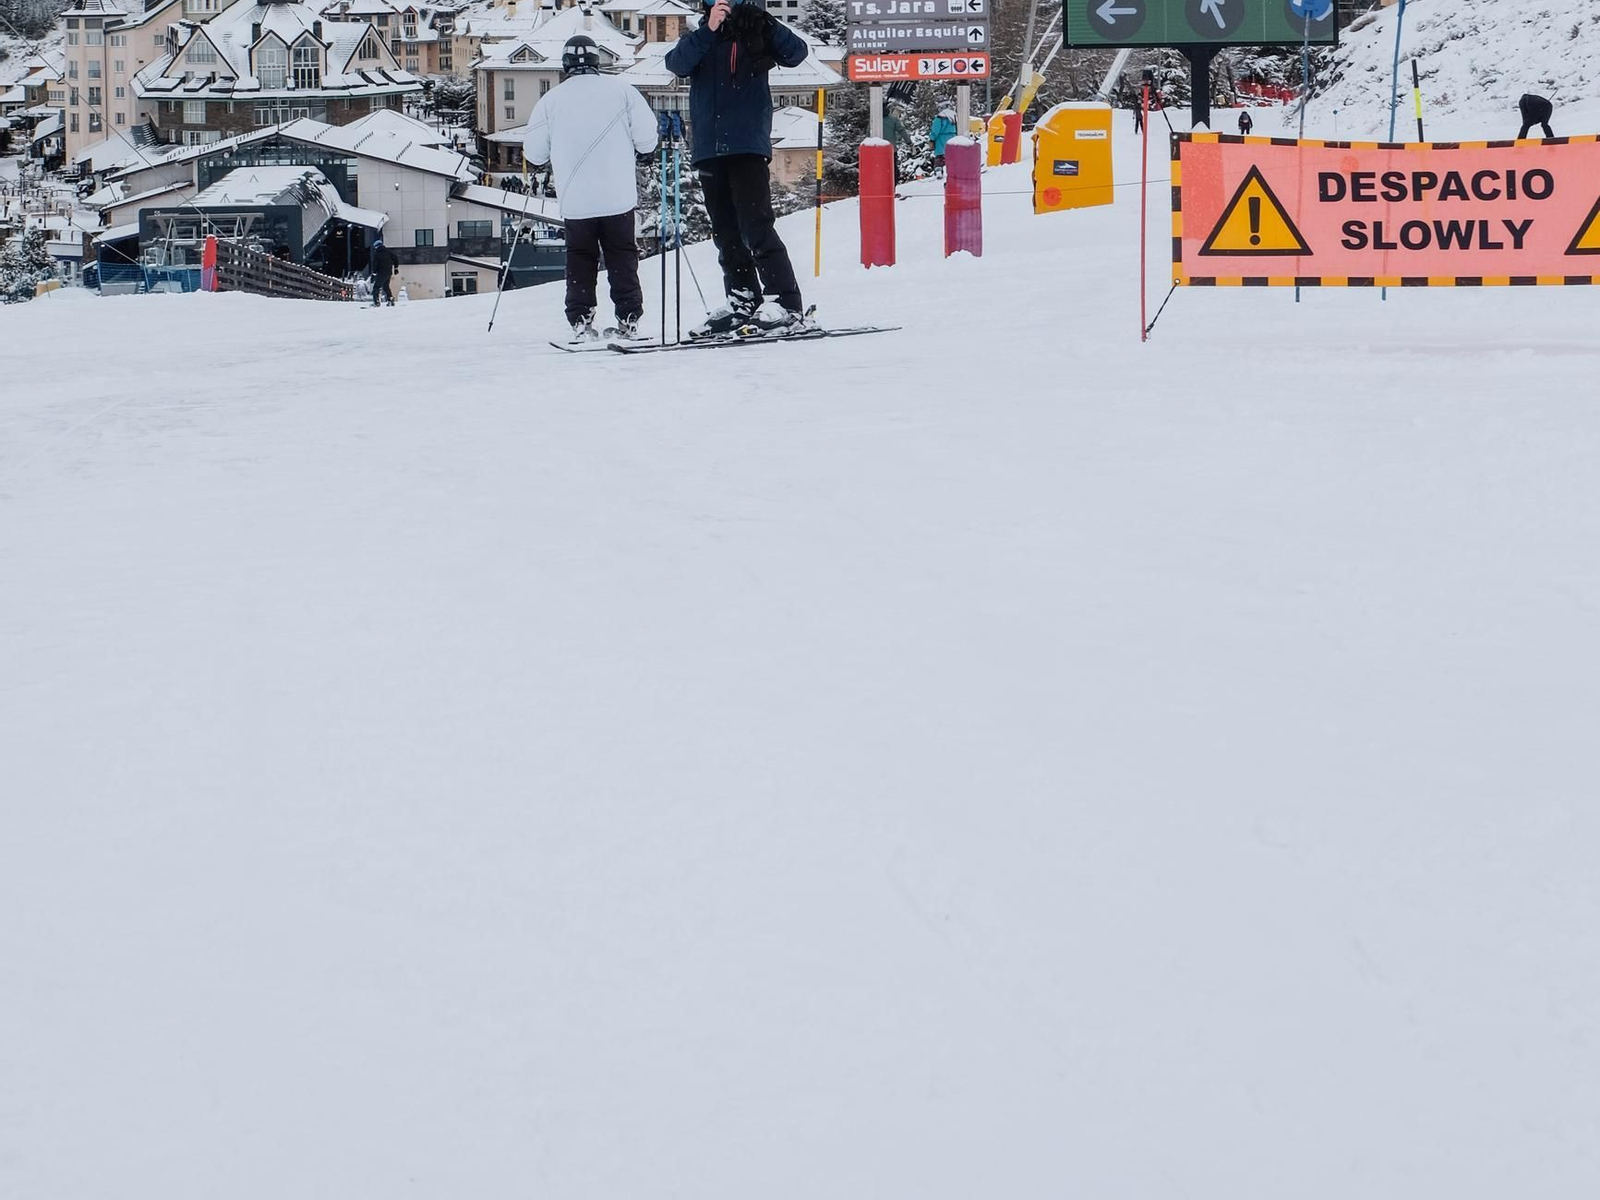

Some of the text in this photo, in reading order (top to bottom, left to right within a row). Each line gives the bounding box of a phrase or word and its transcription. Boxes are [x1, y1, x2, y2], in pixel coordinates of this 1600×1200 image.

[852, 0, 936, 15] Ts. Jara
[853, 25, 966, 40] Alquiler Esquís
[855, 58, 910, 73] Sulayr
[1318, 168, 1555, 203] DESPACIO
[1341, 218, 1534, 251] SLOWLY
